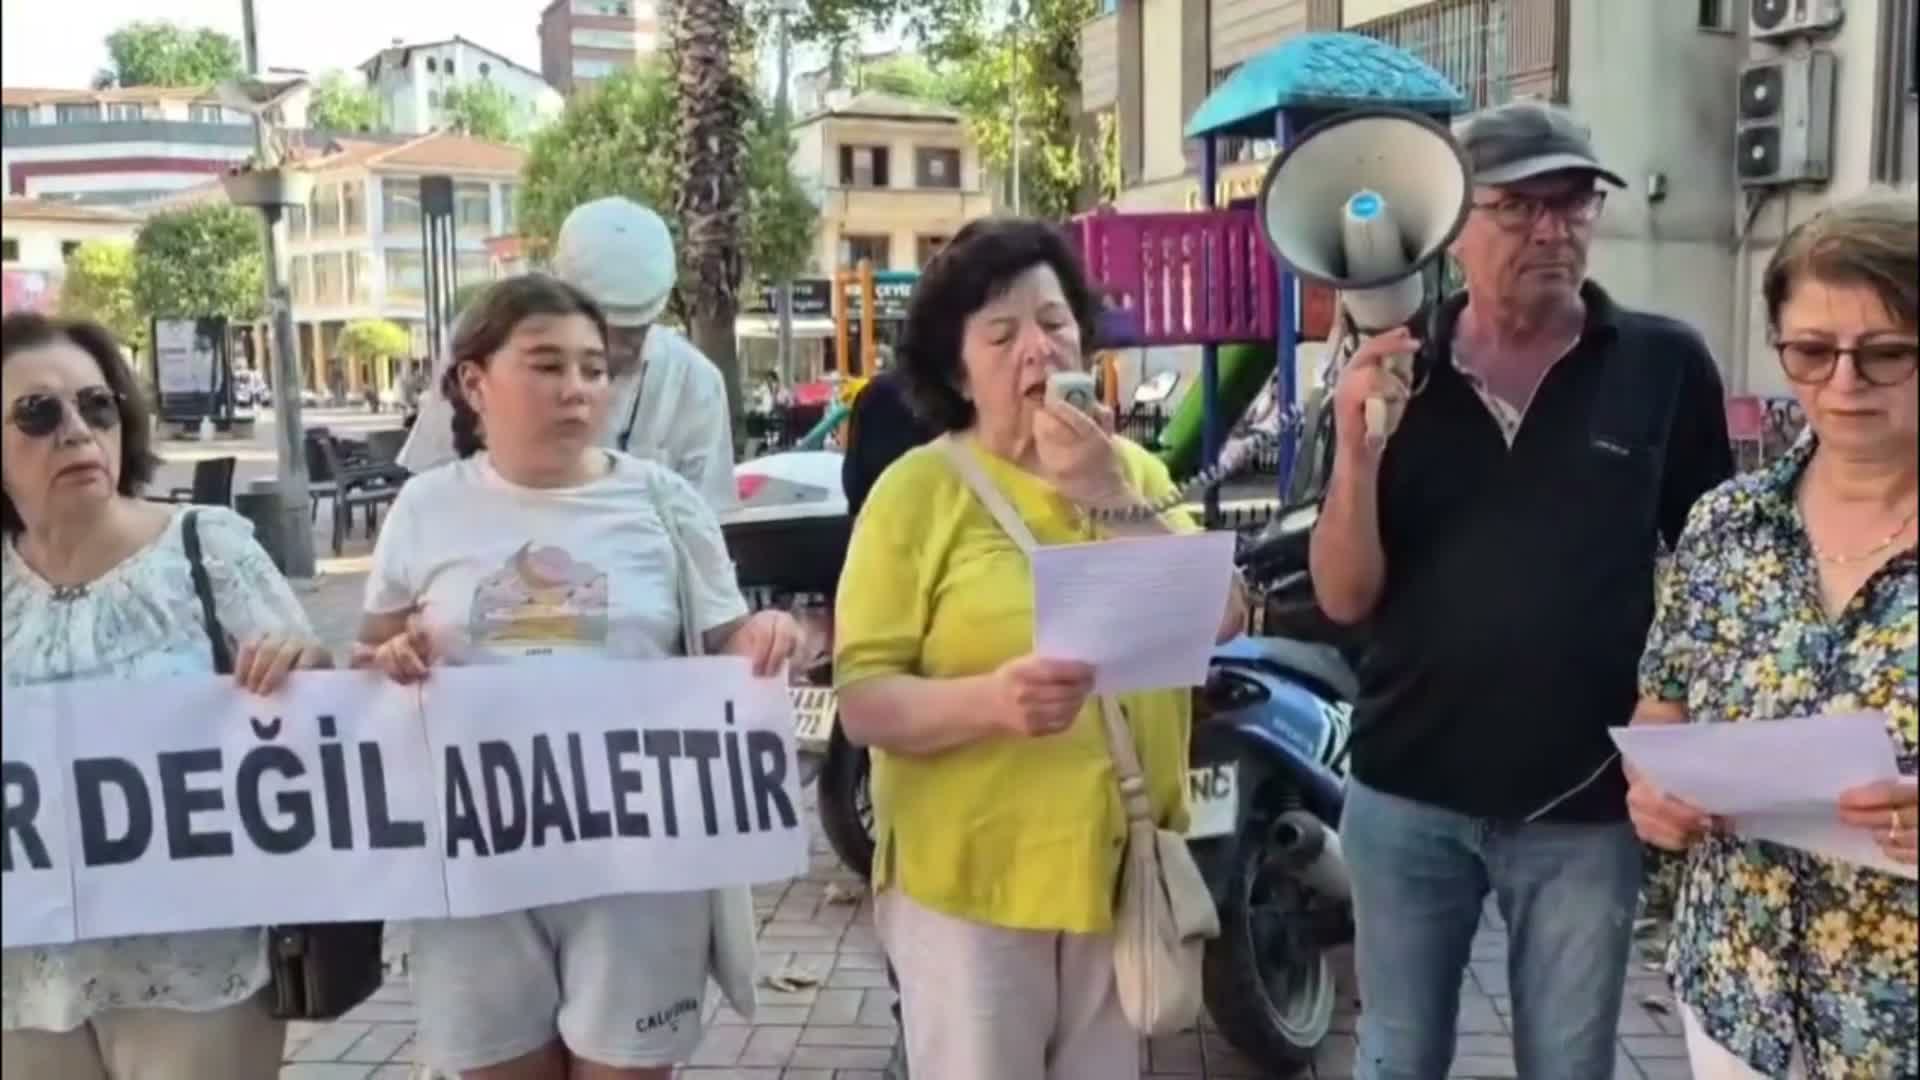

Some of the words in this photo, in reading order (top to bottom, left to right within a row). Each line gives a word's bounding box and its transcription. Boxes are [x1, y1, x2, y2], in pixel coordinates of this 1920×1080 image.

[2, 761, 53, 872] R
[73, 715, 426, 867] DEĞİL
[444, 700, 798, 858] ADALETTİR
